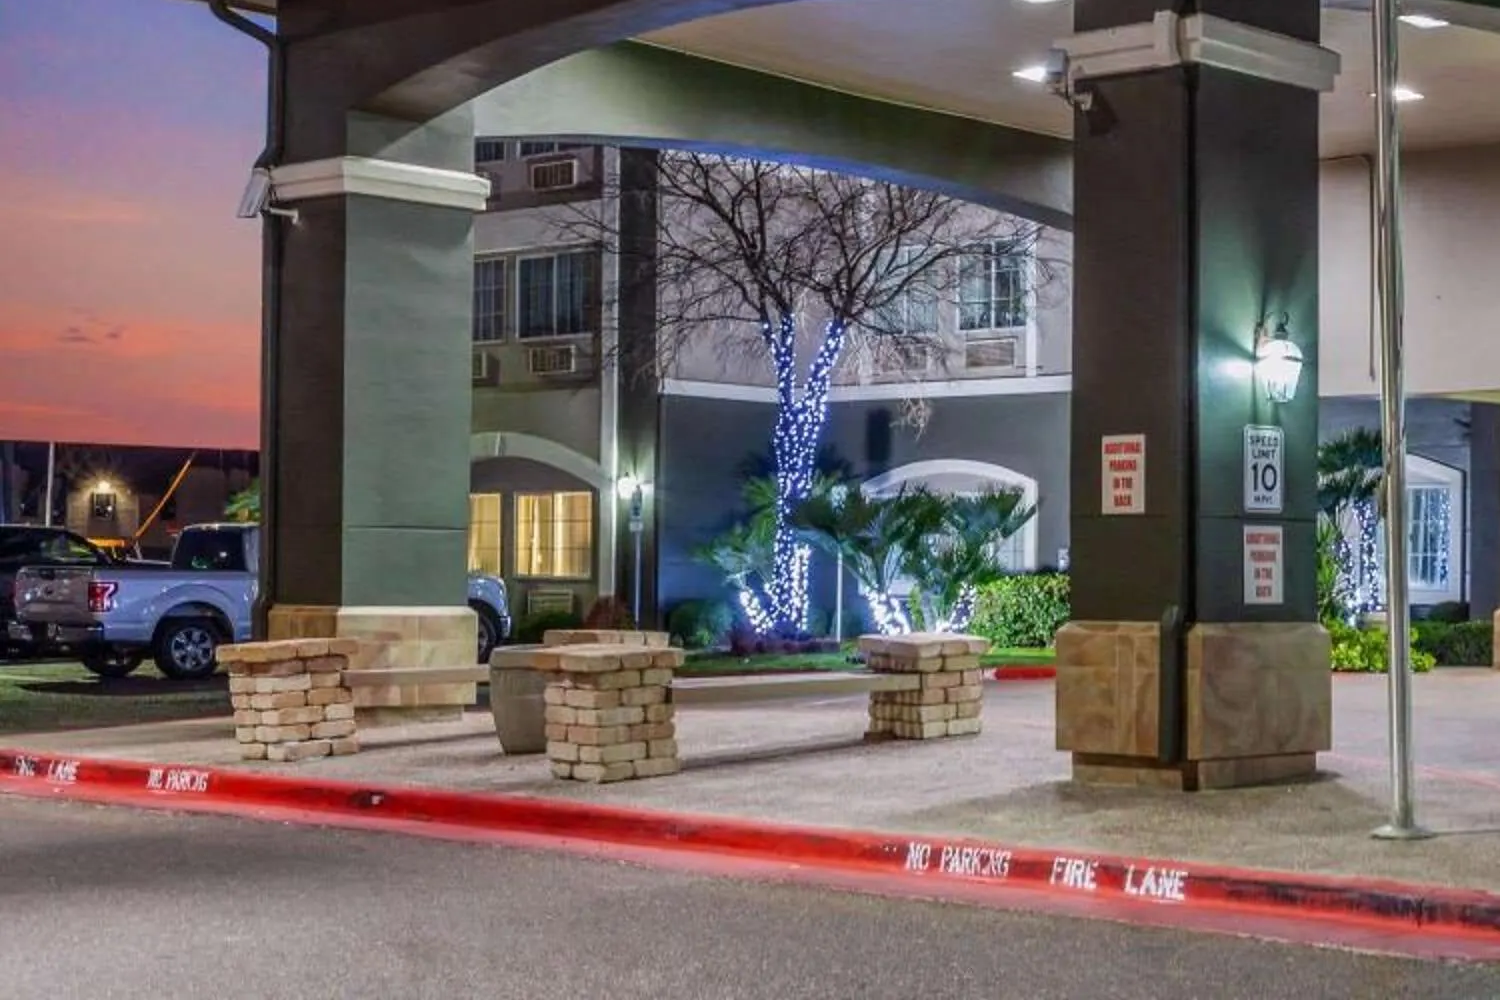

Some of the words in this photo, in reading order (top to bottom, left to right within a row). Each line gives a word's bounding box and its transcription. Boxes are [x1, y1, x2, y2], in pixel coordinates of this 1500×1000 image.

[1249, 435, 1279, 447] SPEED
[1251, 448, 1277, 459] LIMIT
[1252, 462, 1277, 492] 10
[905, 841, 931, 870] NO
[940, 845, 1011, 877] PARKING
[1049, 857, 1099, 889] FIRE
[1123, 864, 1189, 901] LANE
